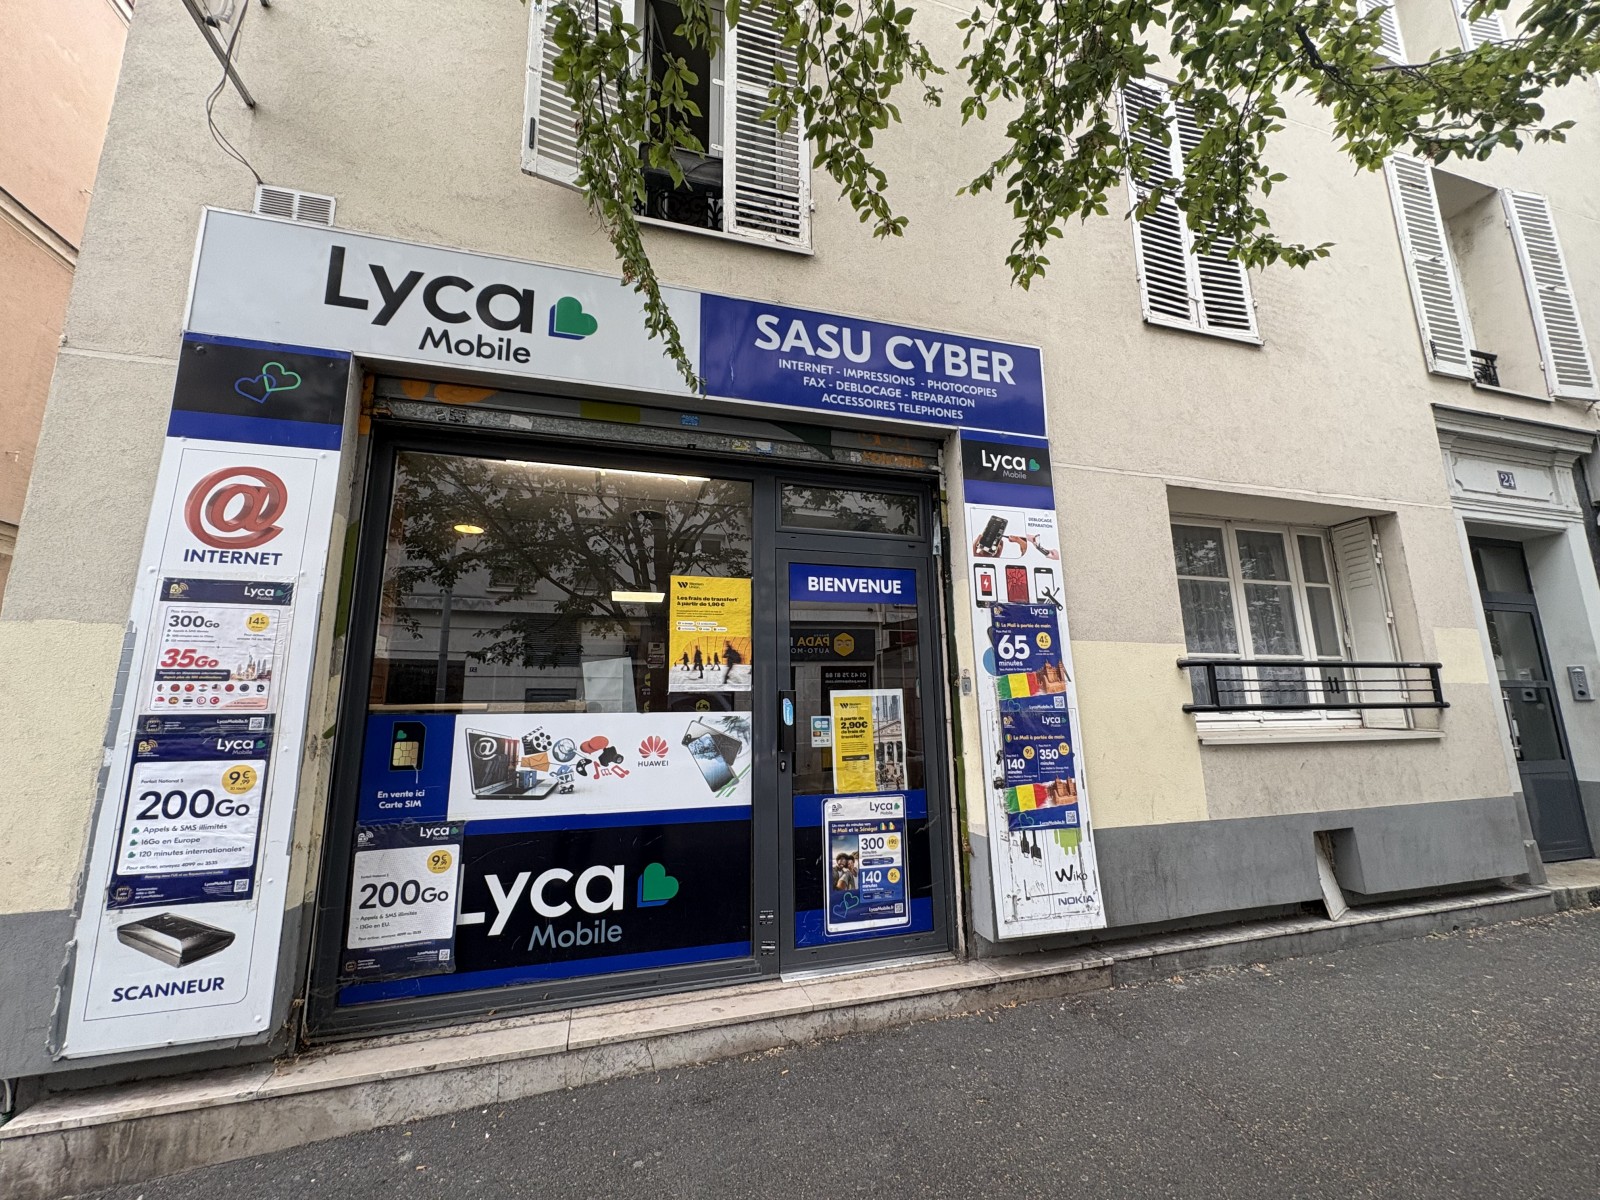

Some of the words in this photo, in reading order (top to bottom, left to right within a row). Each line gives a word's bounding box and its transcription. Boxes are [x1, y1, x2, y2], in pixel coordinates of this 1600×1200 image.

[324, 245, 535, 334] Lyca
[418, 326, 532, 364] Mobile
[754, 313, 872, 363] SASU
[885, 335, 1016, 385] CYBER
[778, 358, 833, 375] INTERNET
[843, 367, 915, 387] IMPRESSIONS
[927, 379, 998, 398] PHOTOCOPIES
[803, 376, 826, 390] FAX
[836, 380, 902, 399] DEBLOCAGE
[911, 390, 975, 408] REPARATION
[822, 393, 896, 412] ACCESSOIRES
[897, 402, 964, 420] TELEPHONES
[981, 449, 1026, 472] Lyca
[1003, 470, 1027, 480] Mobile
[1500, 473, 1514, 486] 24
[183, 549, 283, 566] INTERNET
[244, 586, 274, 598] Lyca
[807, 576, 902, 594] BIENVENUE
[1030, 607, 1048, 616] Lyca
[168, 615, 220, 628] 300Go
[998, 634, 1031, 660] 65
[160, 648, 219, 668] 35Go
[840, 721, 868, 730] 2,90€
[1041, 715, 1061, 725] Lyca
[216, 738, 254, 752] Lyca
[1039, 748, 1059, 760] 350
[637, 759, 669, 767] HUAWEI
[1006, 758, 1025, 770] 140
[377, 790, 388, 798] En
[389, 790, 414, 799] vente
[415, 789, 425, 797] ici
[136, 789, 250, 820] 200Go
[379, 800, 404, 809] Carte
[405, 800, 422, 809] SIM
[869, 801, 893, 812] Lyca
[143, 826, 170, 834] Appels
[419, 827, 450, 839] Lyca
[861, 836, 884, 850] 300
[139, 850, 152, 858] 120
[153, 849, 184, 857] minutes
[861, 870, 882, 884] 140
[1055, 864, 1088, 882] Wiko
[358, 879, 449, 910] 200Go
[456, 863, 625, 937] Lyca
[1058, 895, 1095, 906] NOKIA
[360, 914, 378, 922] Appels
[528, 918, 623, 952] Mobile
[111, 977, 225, 1003] SCANNEUR
